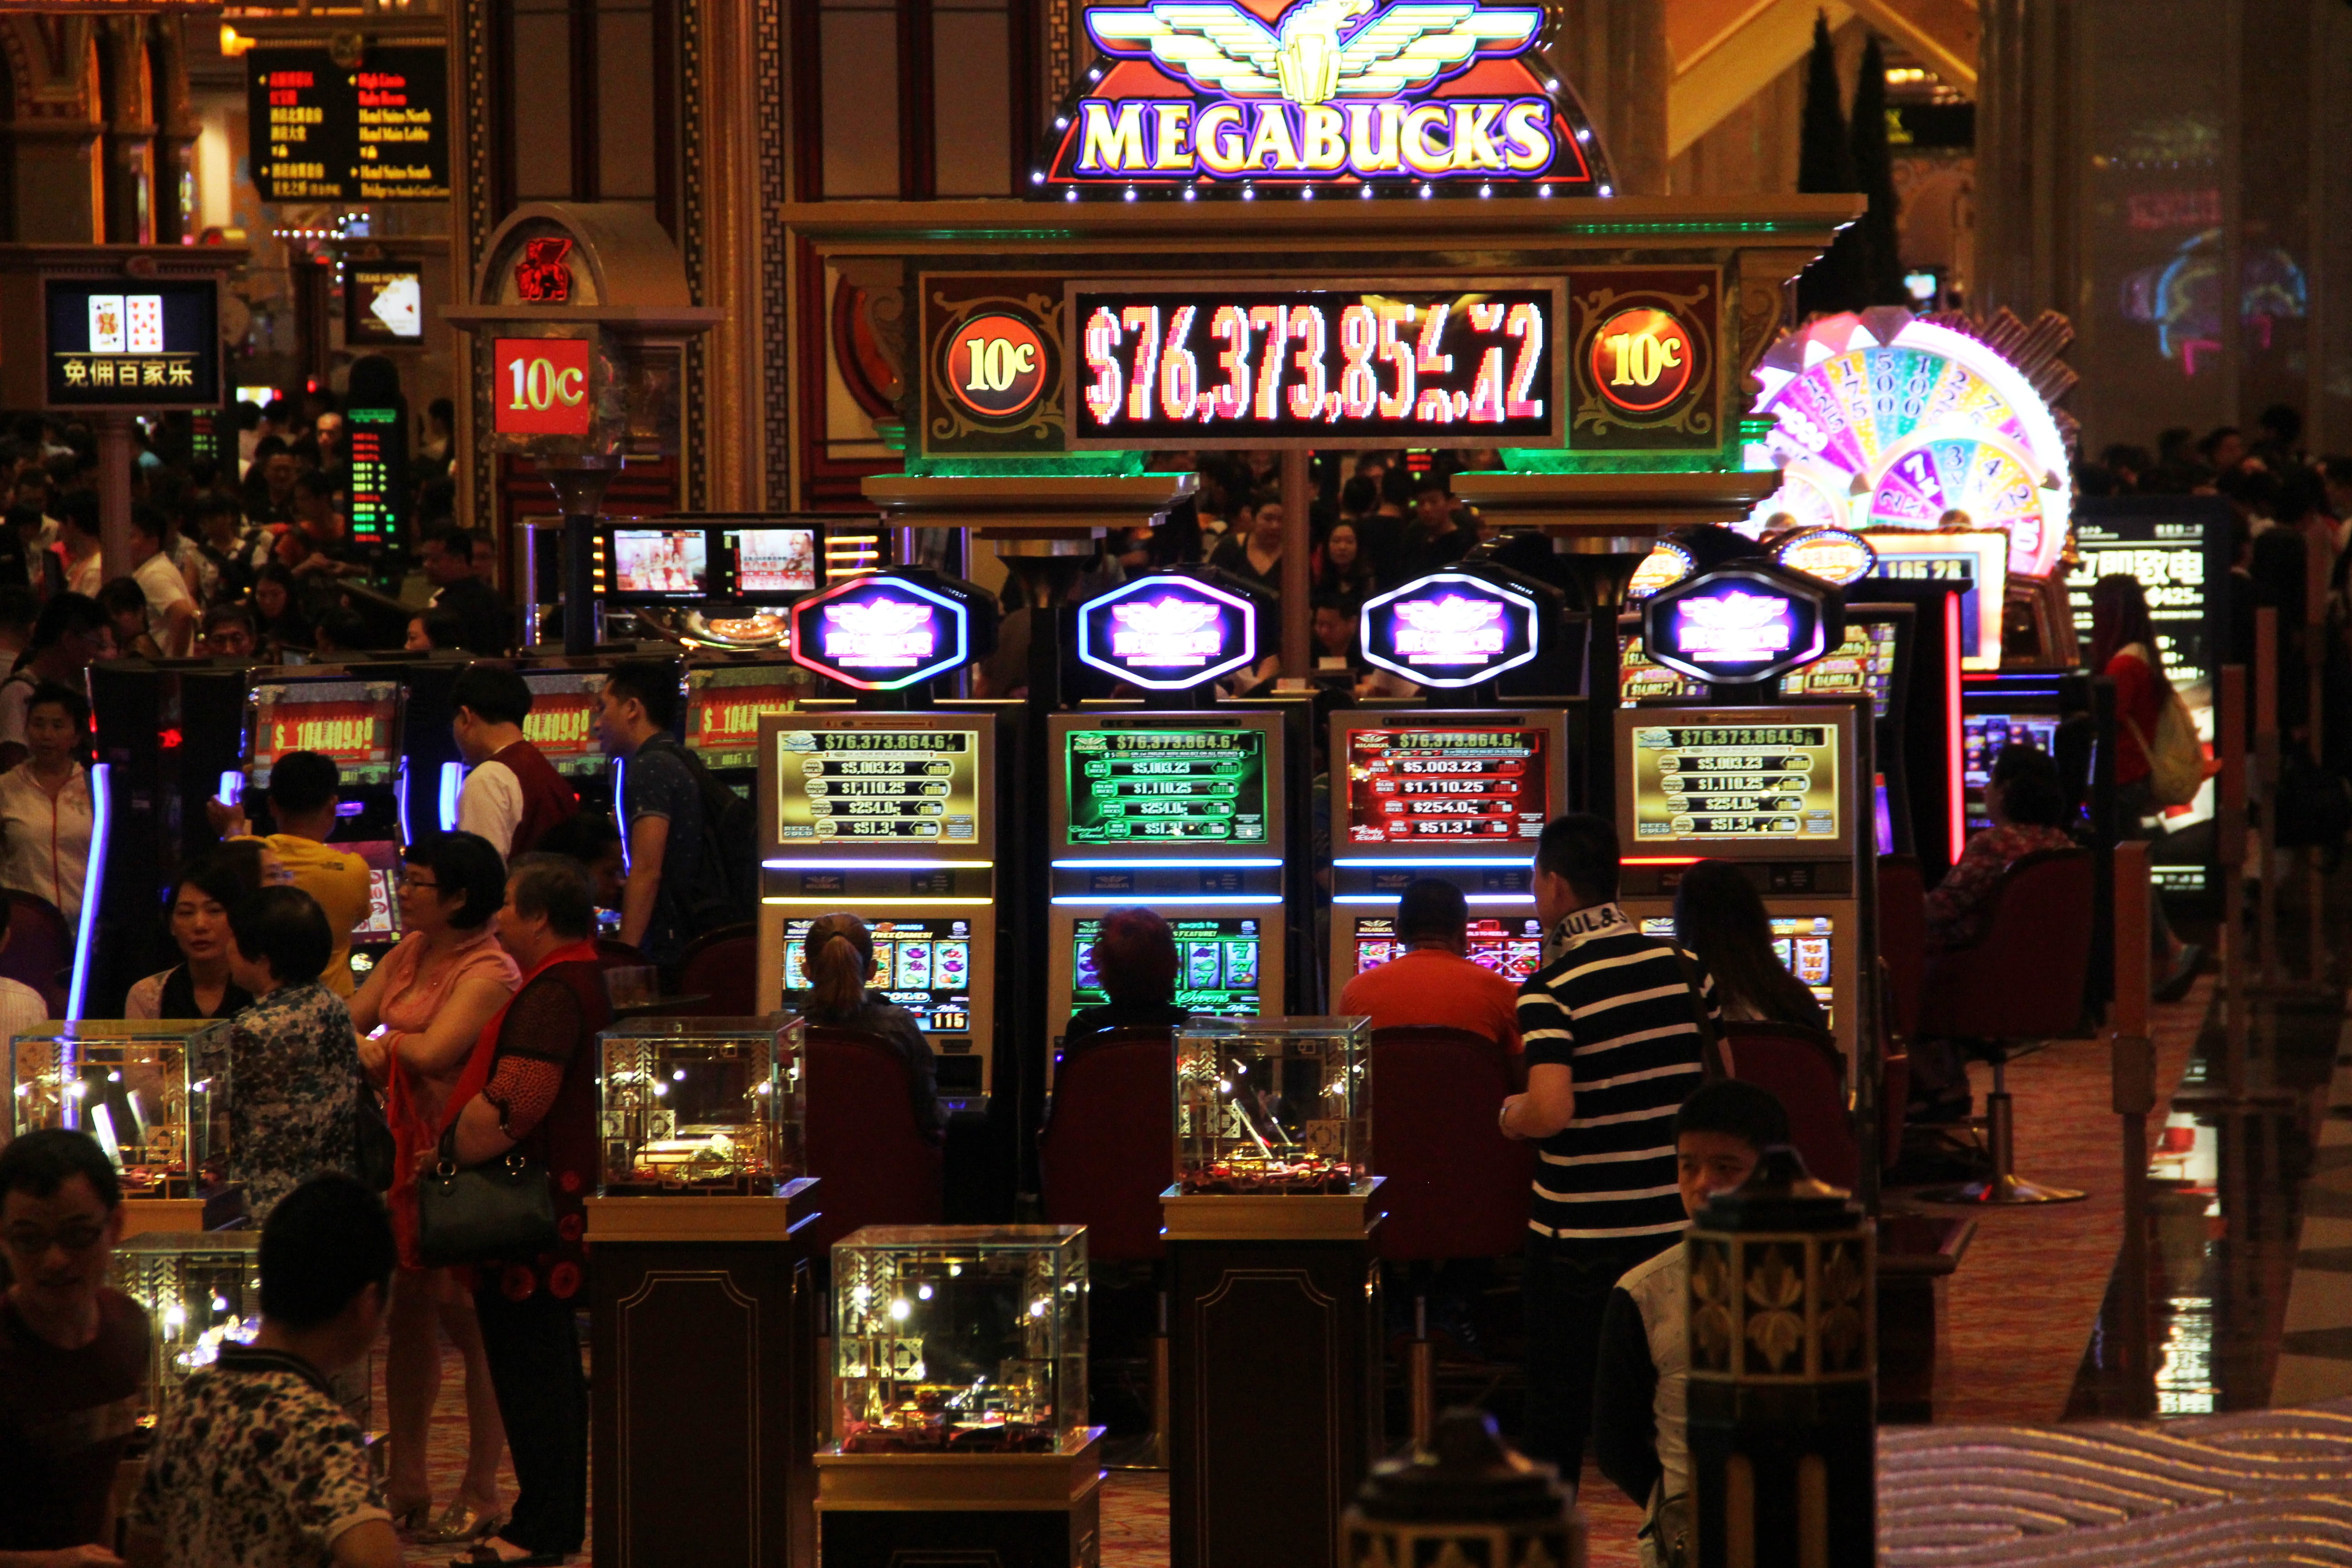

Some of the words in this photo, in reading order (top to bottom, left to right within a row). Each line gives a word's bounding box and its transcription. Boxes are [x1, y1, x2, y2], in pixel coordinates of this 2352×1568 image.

[1079, 103, 1550, 171] MEGABUCKS
[63, 358, 193, 387] 免佣百家乐
[2065, 549, 2204, 586] 立即致电
[841, 761, 905, 774] $5,003.23
[1133, 762, 1190, 774] $5,003.23
[1404, 761, 1482, 773] $5,003.23
[1697, 757, 1763, 770] $5,003.23
[842, 781, 906, 795] $1,110.25
[1134, 782, 1192, 795] $1,110.25
[1405, 780, 1484, 794] $1,110.25
[1698, 777, 1764, 790] $1,110.25
[1178, 990, 1231, 1003] Sevens
[1227, 1004, 1250, 1012] Win
[934, 1013, 965, 1028] 115
